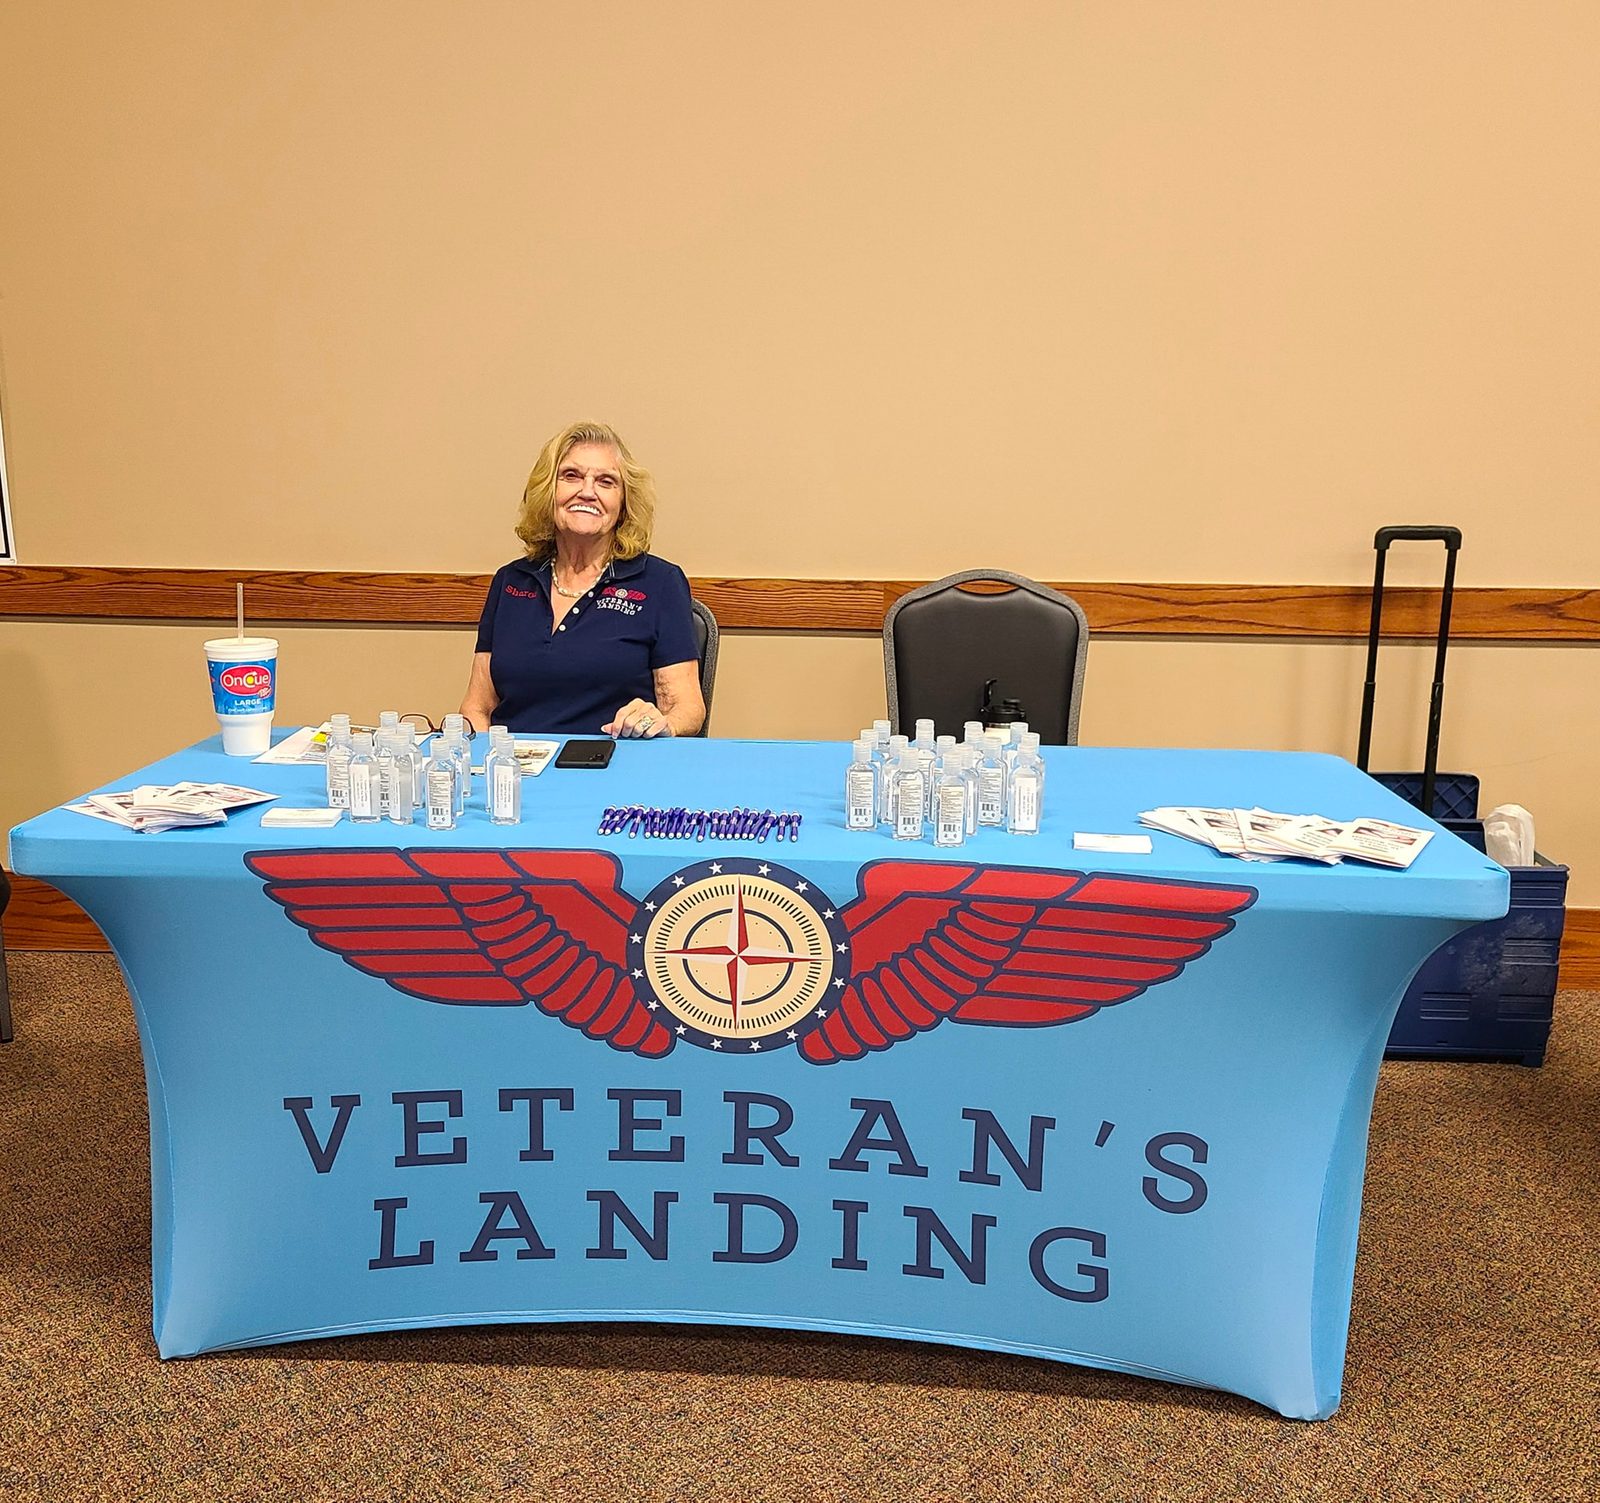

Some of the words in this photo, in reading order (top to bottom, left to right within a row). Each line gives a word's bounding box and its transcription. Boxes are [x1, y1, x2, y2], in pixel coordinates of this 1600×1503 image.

[596, 597, 643, 612] VETERAN'S
[596, 602, 636, 616] LANDING
[222, 671, 269, 689] OnCue
[234, 698, 262, 706] LARGE
[283, 1087, 1209, 1215] VETERAN'S
[368, 1190, 1111, 1304] LANDING
